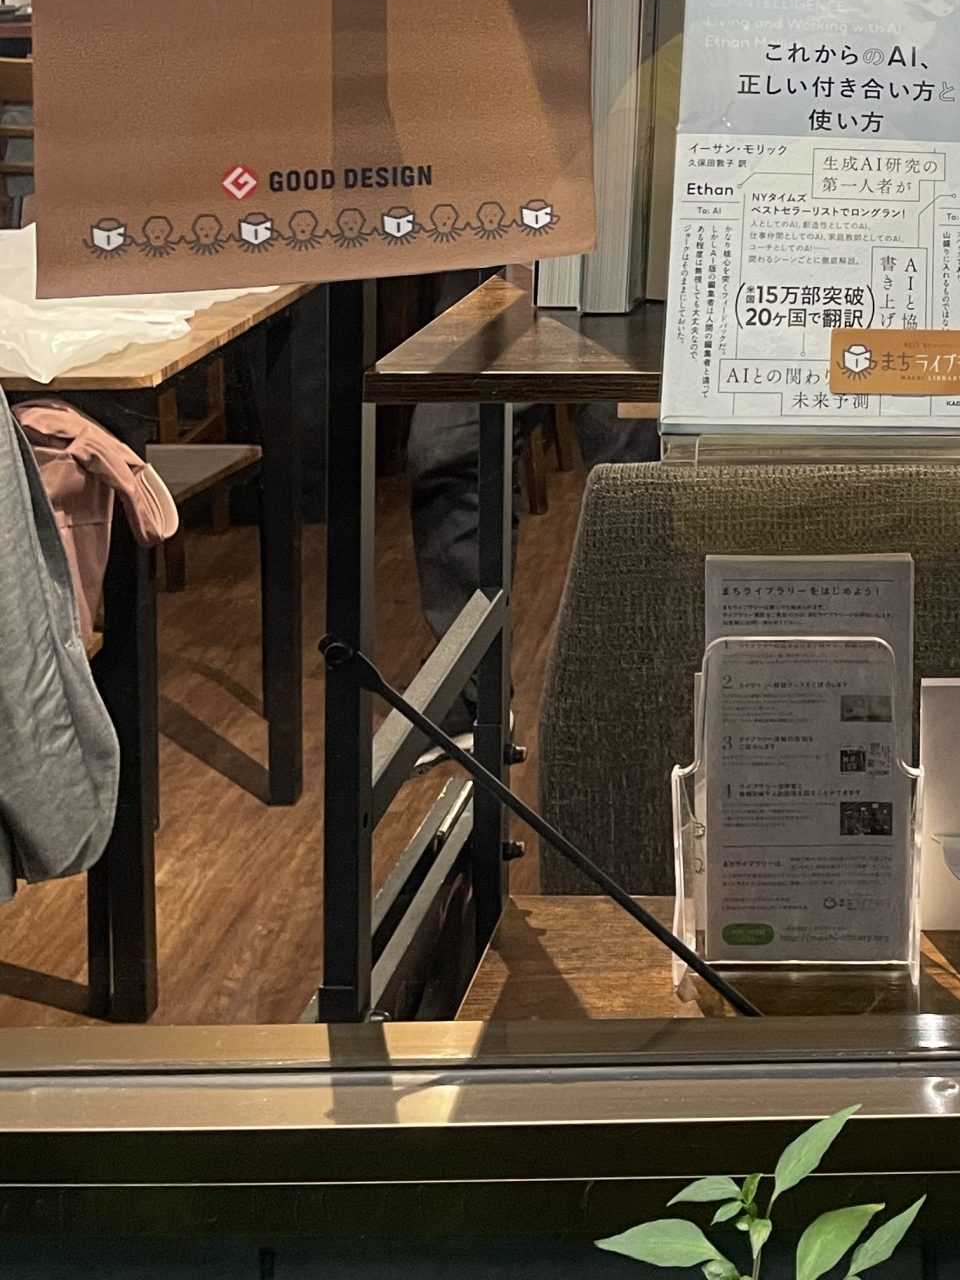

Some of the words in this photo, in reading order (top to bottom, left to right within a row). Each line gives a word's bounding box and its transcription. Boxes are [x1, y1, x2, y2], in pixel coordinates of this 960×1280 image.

[706, 17, 748, 30] Living
[754, 18, 782, 29] and
[788, 18, 847, 36] Working
[853, 22, 884, 33] with
[888, 23, 902, 34] AI
[705, 35, 749, 48] Ethan
[765, 42, 929, 70] これからのAI、
[737, 74, 956, 103] 正しい付き合い方と
[808, 109, 884, 133] 使い方
[689, 143, 787, 155] イーサン・モリック
[738, 159, 747, 168] 訳
[822, 155, 938, 173] 生成AI研究の
[269, 169, 336, 193] GOOD
[344, 165, 433, 190] DESIGN
[822, 176, 912, 195] 第一人者が
[687, 182, 734, 196] Ethan
[752, 193, 807, 203] NYタイムズ
[880, 255, 897, 329] 書き上げ
[792, 392, 868, 409] 未来予測
[722, 674, 733, 689] 2
